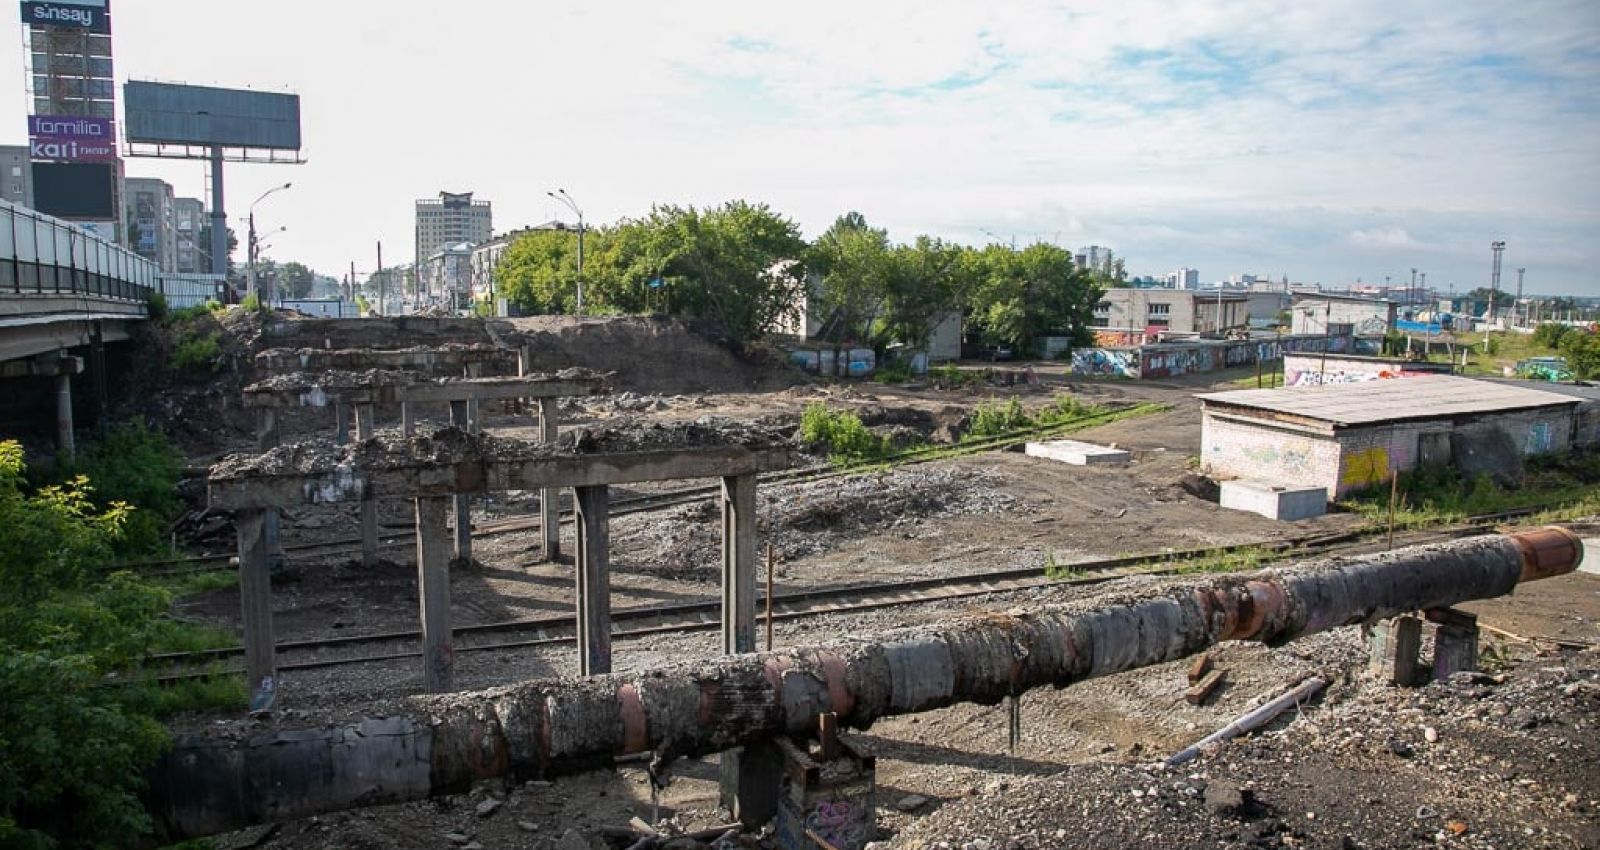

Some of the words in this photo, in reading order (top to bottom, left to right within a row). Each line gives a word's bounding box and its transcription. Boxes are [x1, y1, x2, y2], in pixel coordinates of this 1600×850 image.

[34, 4, 92, 26] sinsay
[36, 118, 101, 135] familia
[31, 139, 77, 157] kari
